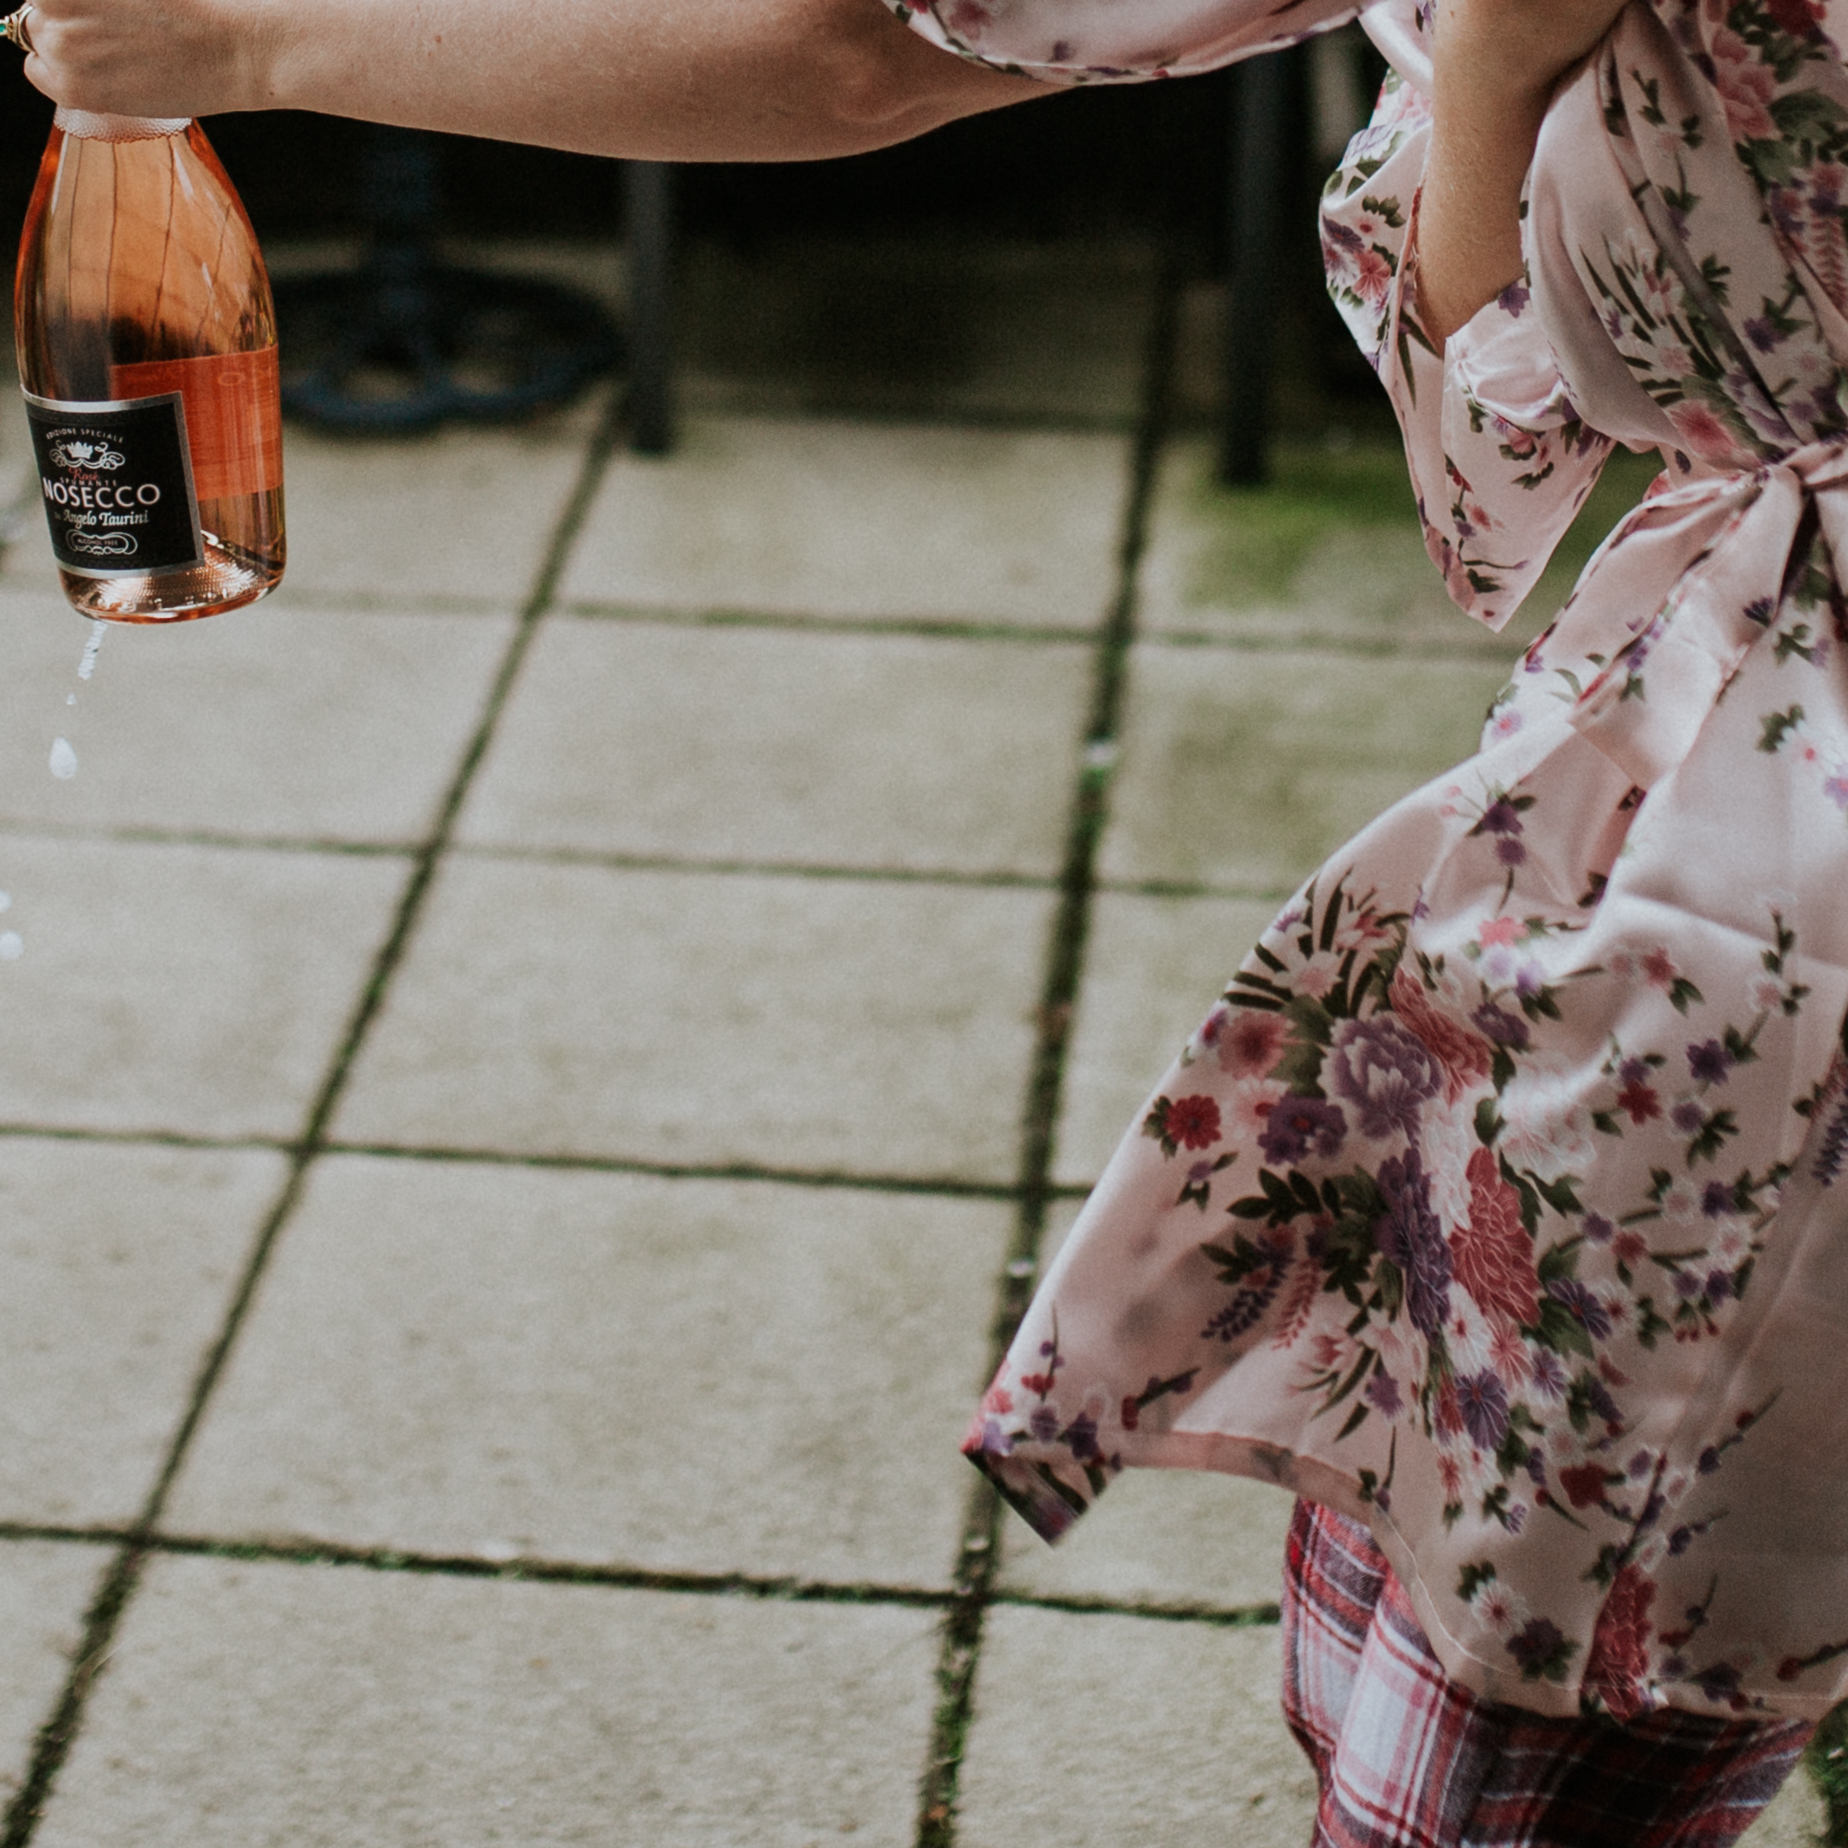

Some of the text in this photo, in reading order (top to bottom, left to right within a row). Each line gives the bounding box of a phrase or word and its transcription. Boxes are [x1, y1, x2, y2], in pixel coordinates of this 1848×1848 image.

[46, 428, 123, 443] EDIZIONE SPECIALE
[60, 477, 117, 486] SPUMANTE
[42, 477, 161, 508] NOSECCO
[63, 509, 97, 529] Angelo
[99, 510, 150, 526] Taurini
